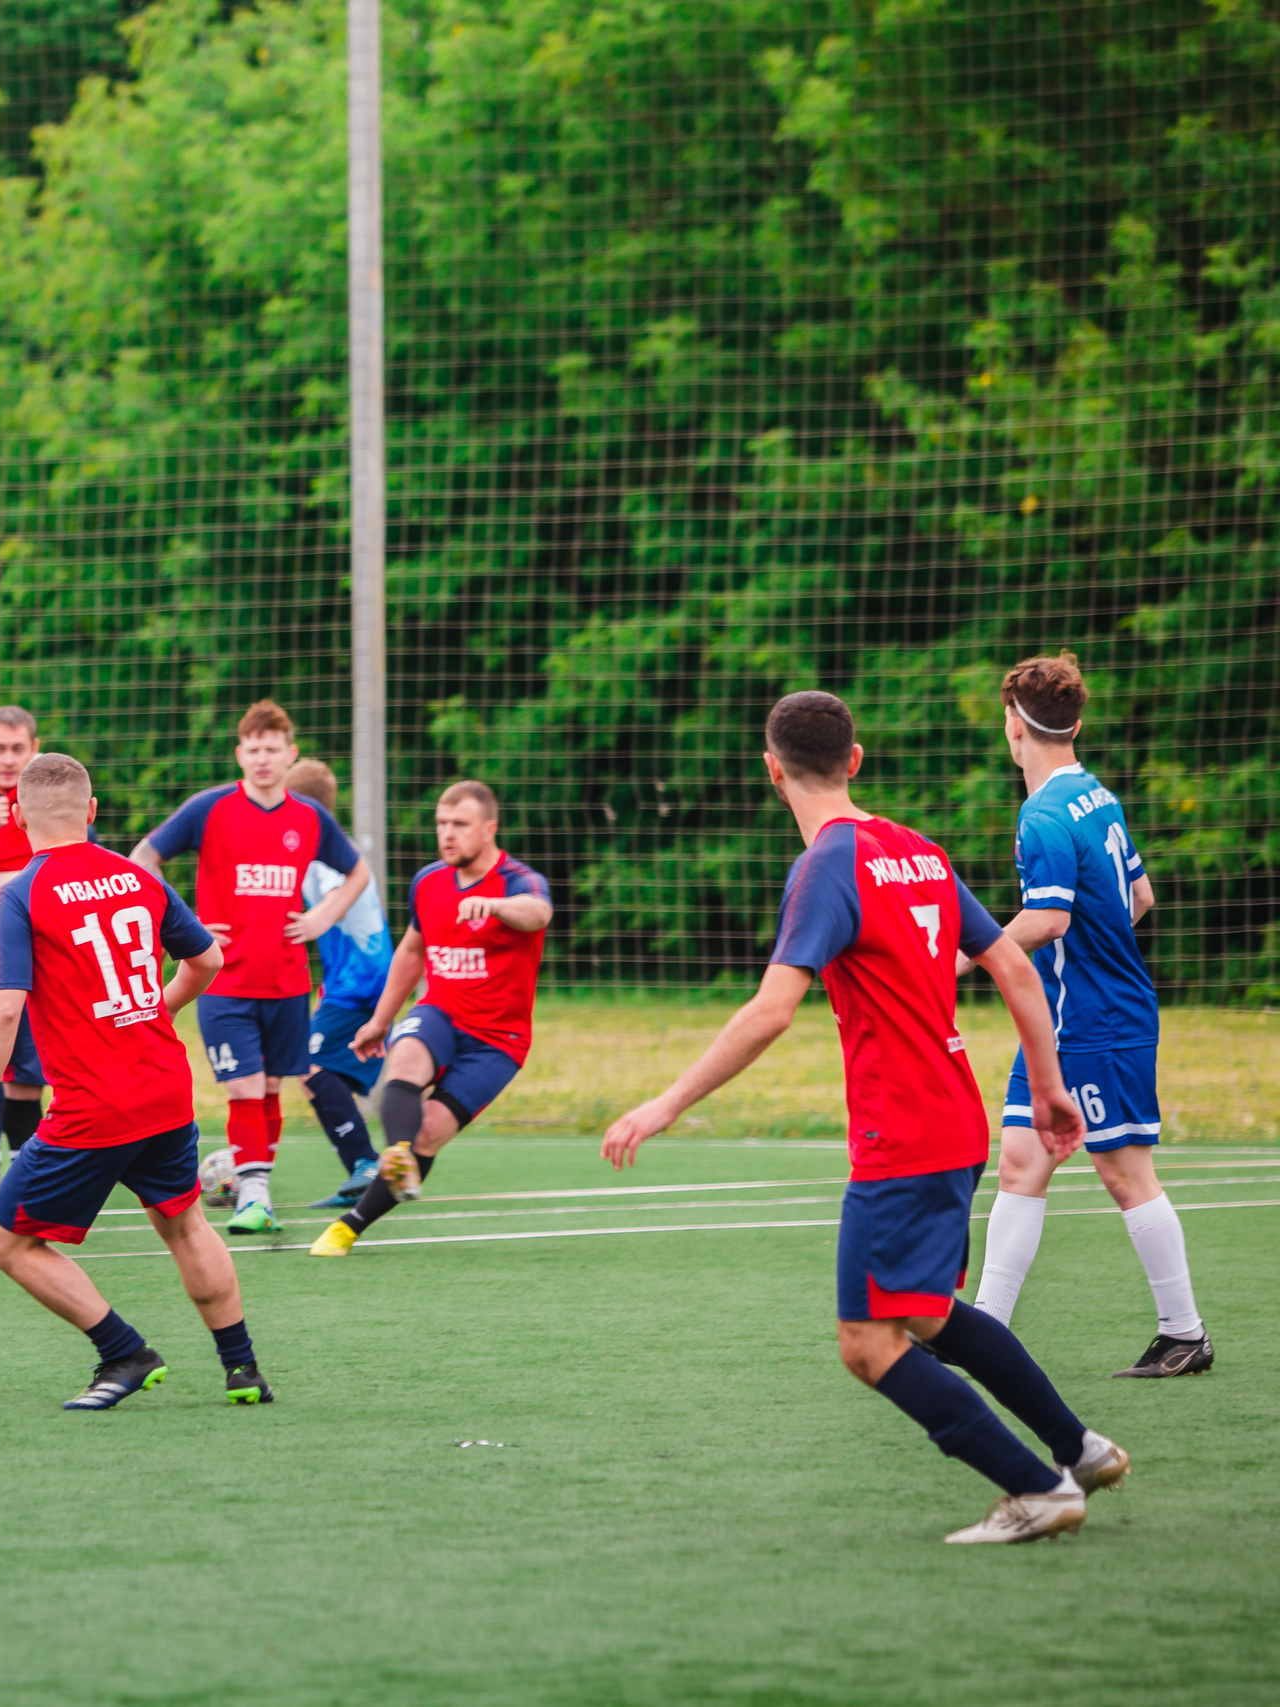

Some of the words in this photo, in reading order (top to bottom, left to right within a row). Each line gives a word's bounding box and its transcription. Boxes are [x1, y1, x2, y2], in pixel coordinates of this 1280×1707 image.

[53, 872, 142, 905] ИВАНОВ
[235, 863, 297, 889] БЗПП
[909, 904, 941, 959] 7
[70, 905, 162, 1020] 13
[1070, 1083, 1107, 1126] 16
